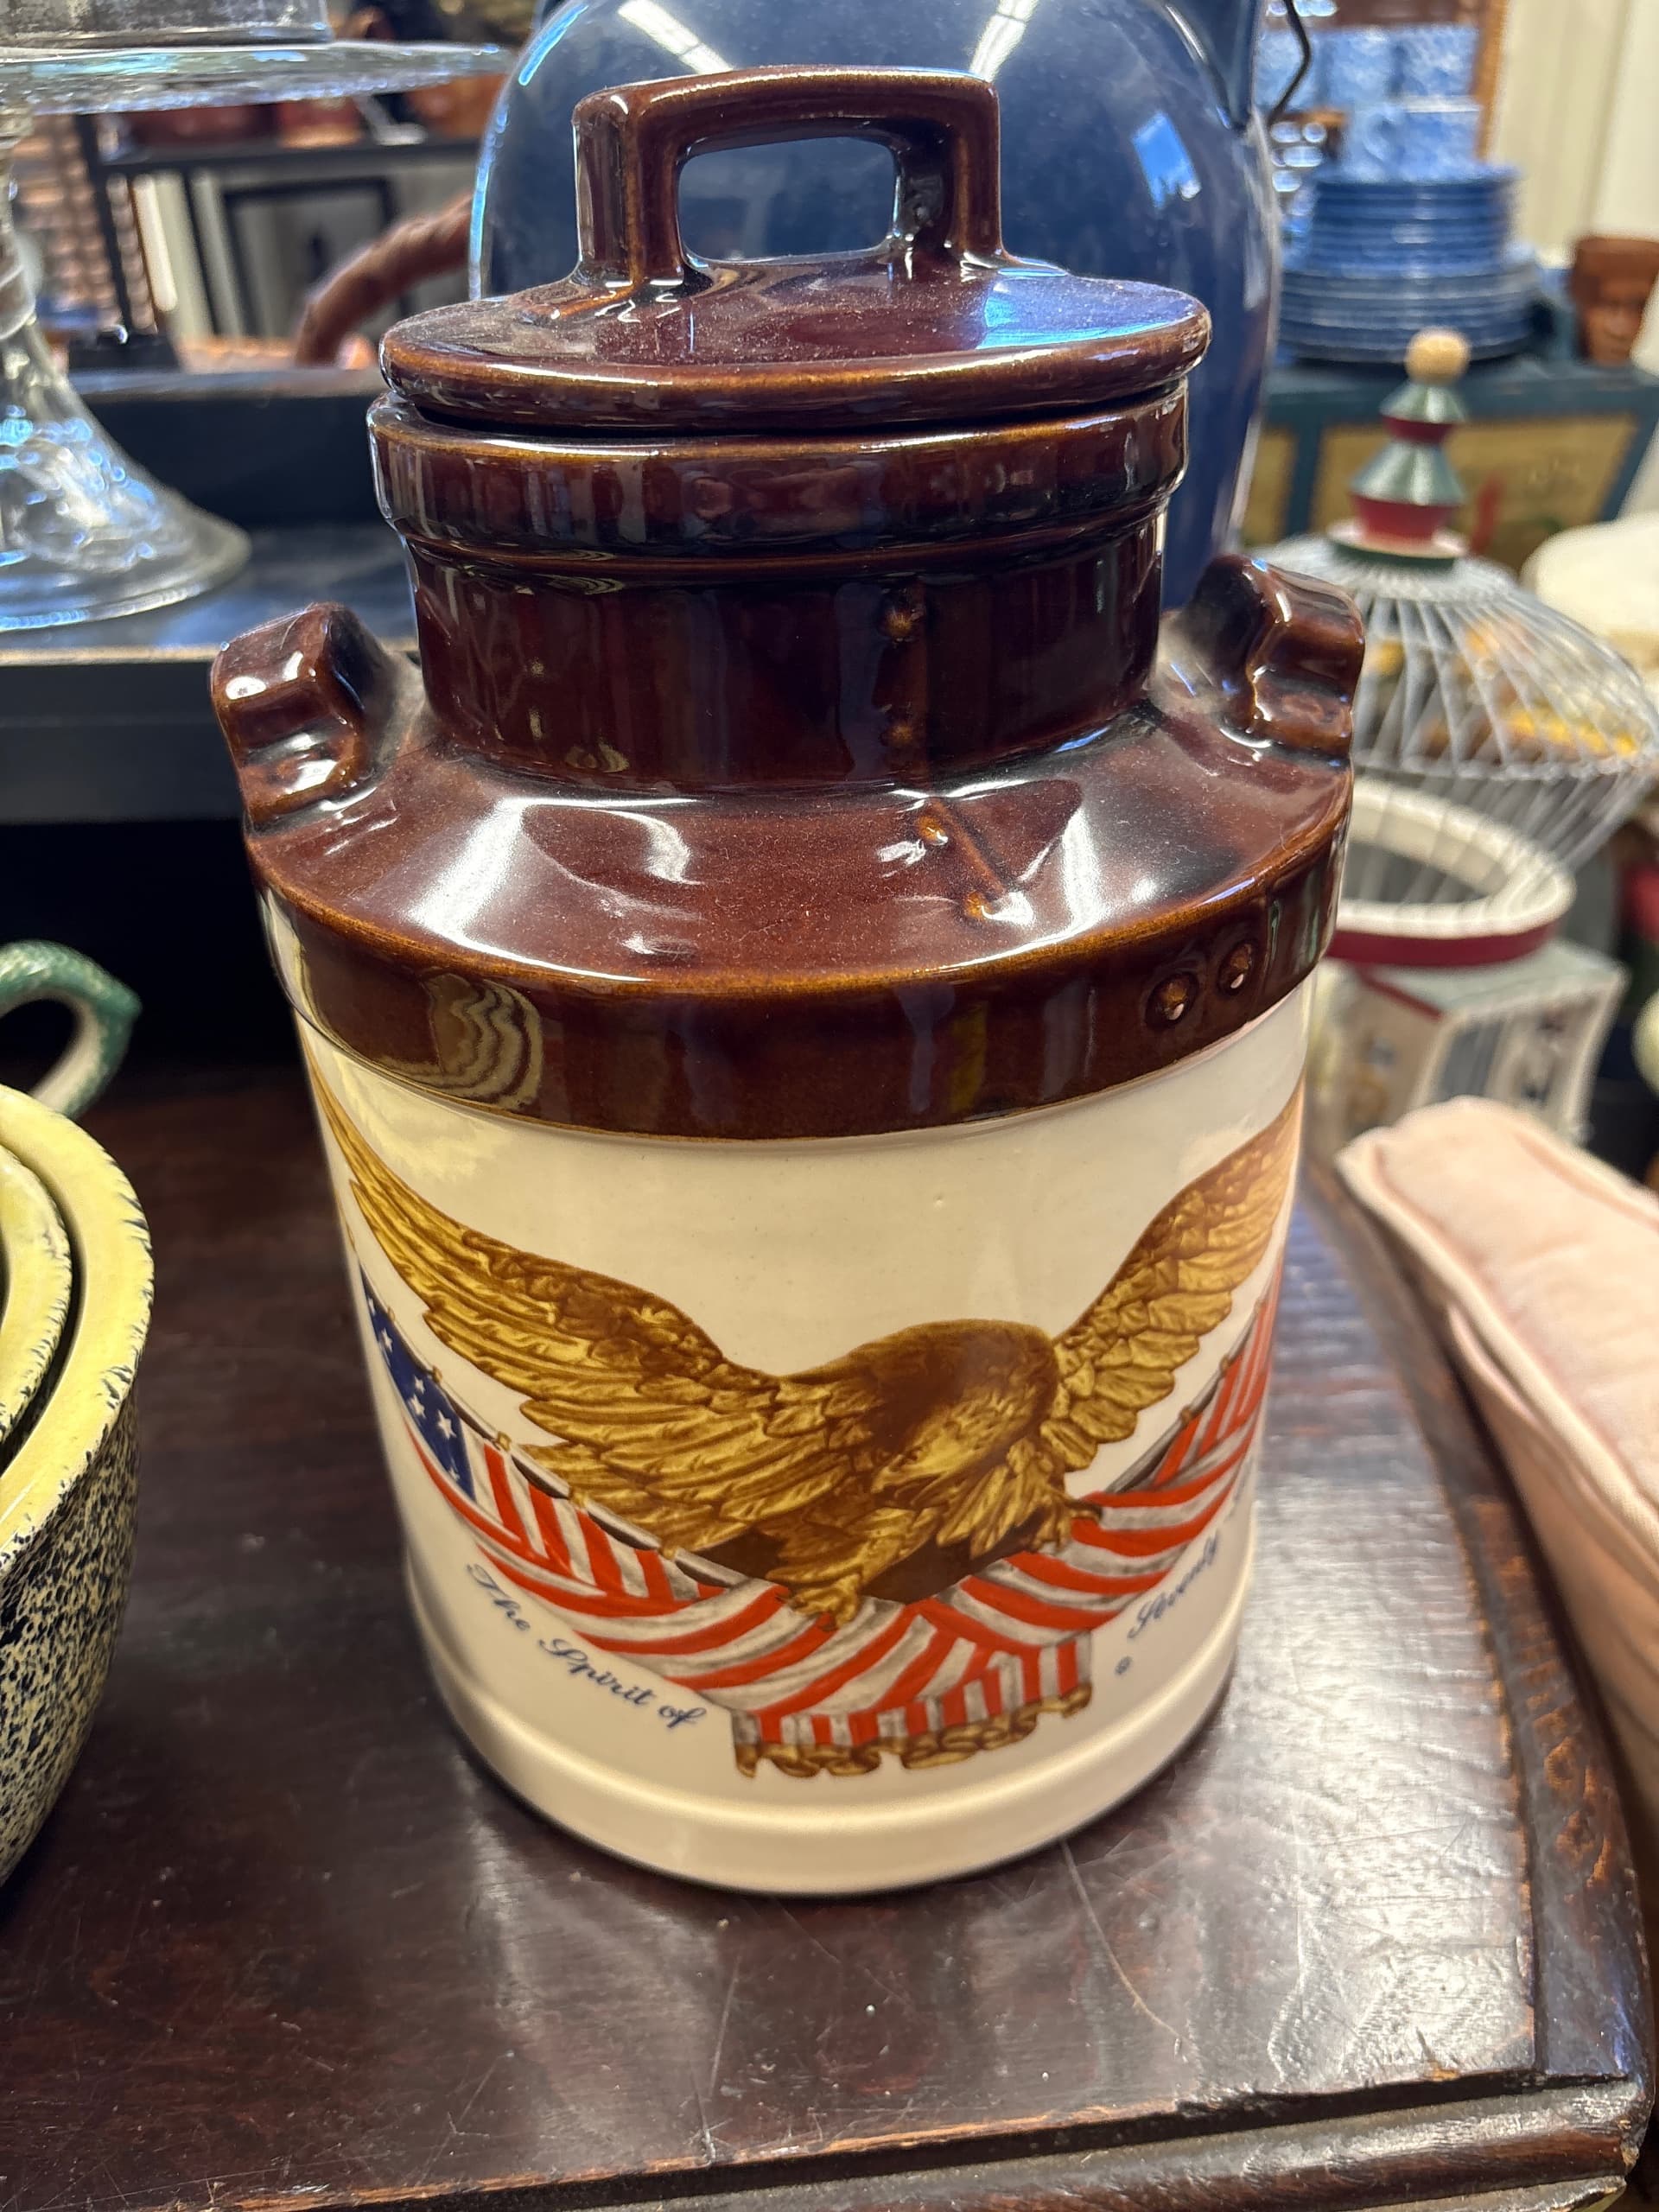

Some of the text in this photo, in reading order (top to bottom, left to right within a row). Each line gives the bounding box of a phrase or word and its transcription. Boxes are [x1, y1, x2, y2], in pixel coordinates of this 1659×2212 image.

[467, 1562, 707, 1728] The Spirit of
